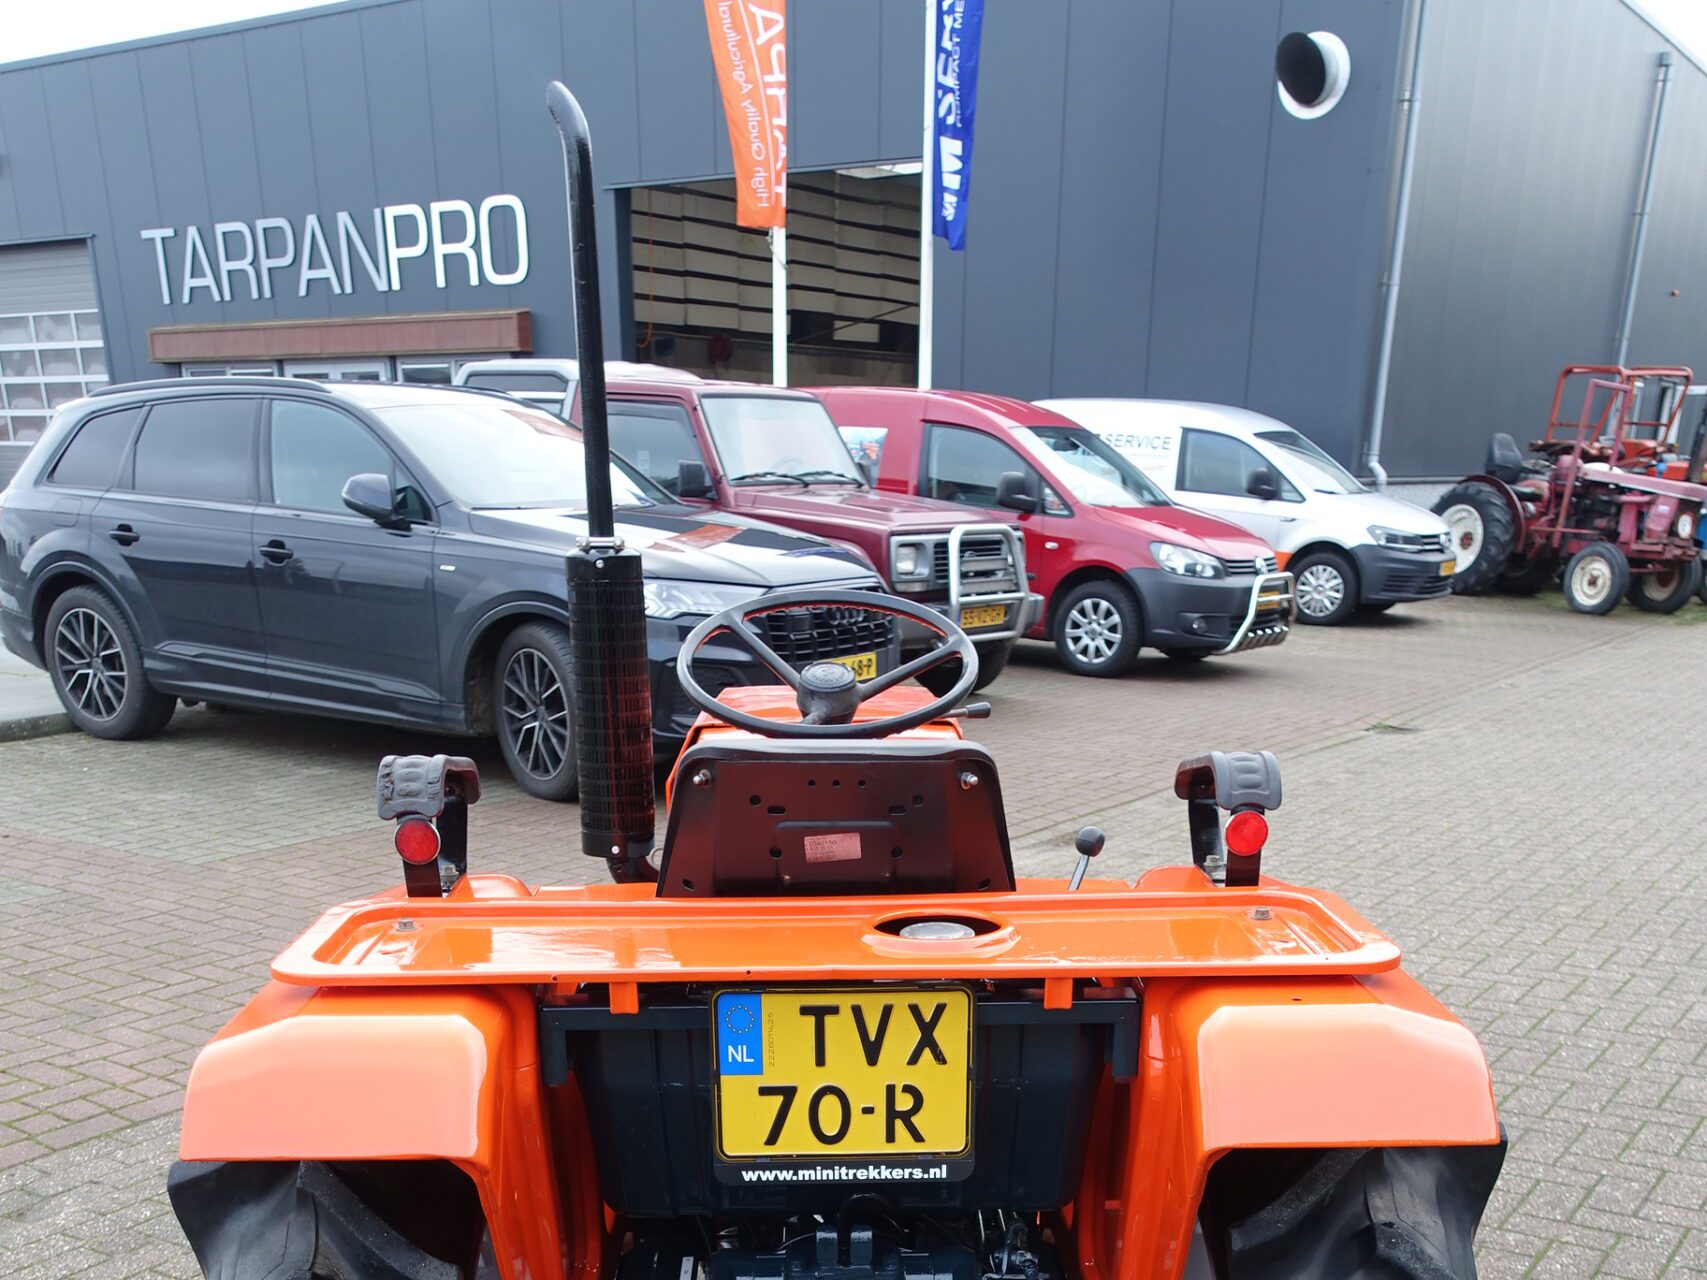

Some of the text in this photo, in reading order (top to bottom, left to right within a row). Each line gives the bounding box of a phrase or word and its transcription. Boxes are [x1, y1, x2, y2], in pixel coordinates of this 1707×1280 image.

[140, 193, 529, 305] TARPANPRO
[1105, 433, 1172, 450] SERVICE
[728, 1045, 754, 1063] NL
[799, 1002, 948, 1068] TVX
[757, 1083, 926, 1146] 70-R
[741, 1164, 948, 1182] www.minitrekkers.nl
